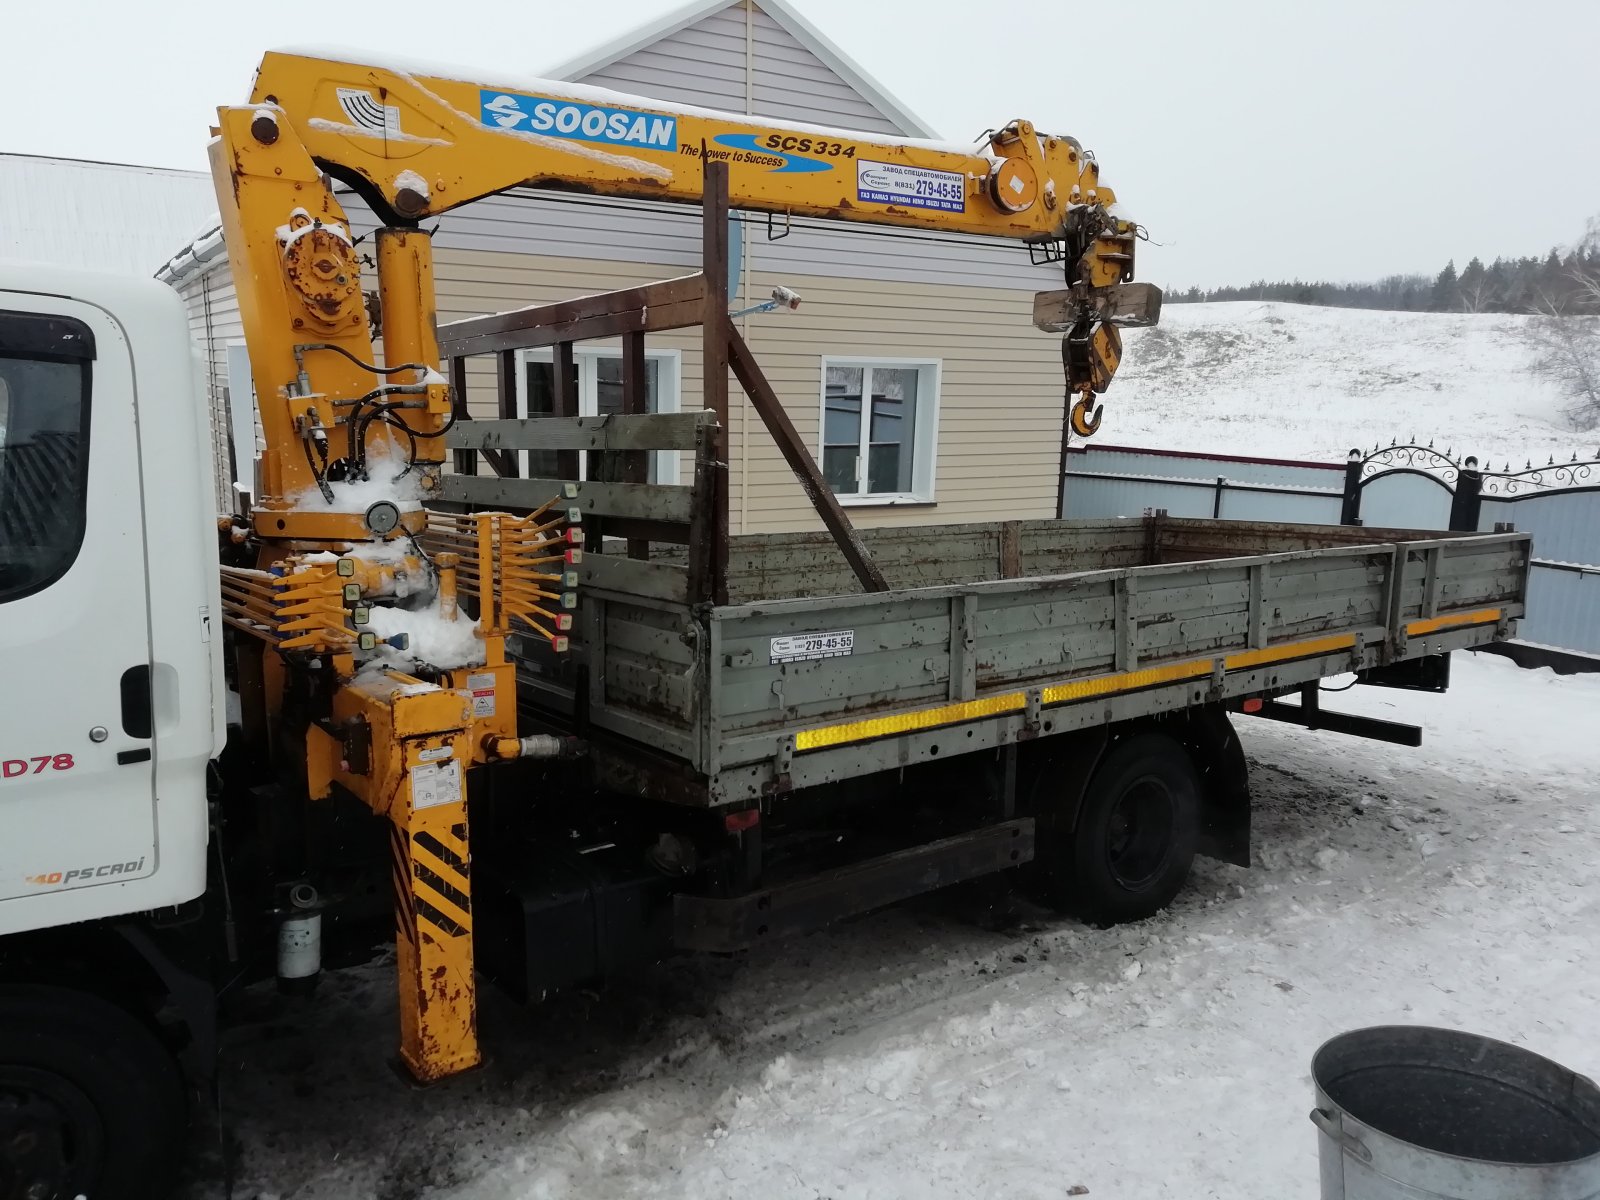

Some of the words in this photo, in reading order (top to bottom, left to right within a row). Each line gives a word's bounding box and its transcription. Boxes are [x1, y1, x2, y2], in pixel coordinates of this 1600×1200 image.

[531, 102, 674, 146] SOOSAN
[680, 143, 699, 156] The
[732, 151, 743, 162] to
[743, 152, 783, 167] Success
[882, 165, 903, 175] ЗАВОД
[894, 181, 916, 190] 8(831)
[916, 180, 962, 200] 279-45-55
[805, 636, 852, 651] 279-45-55
[0, 753, 75, 778] D78
